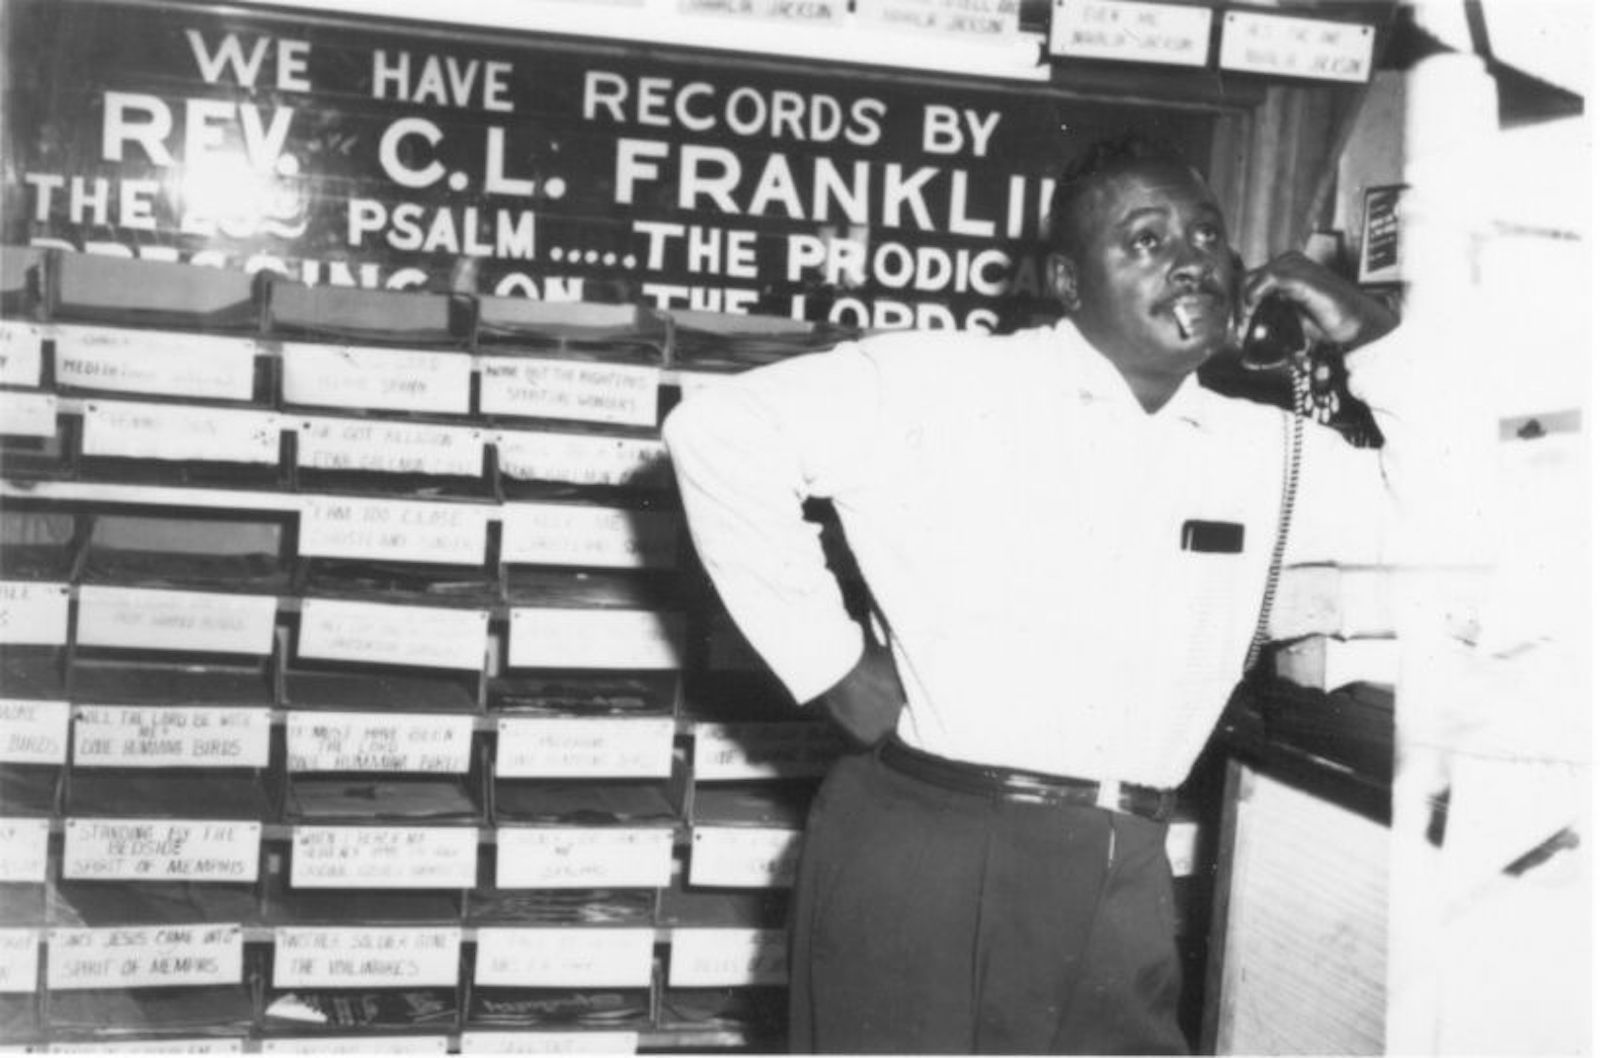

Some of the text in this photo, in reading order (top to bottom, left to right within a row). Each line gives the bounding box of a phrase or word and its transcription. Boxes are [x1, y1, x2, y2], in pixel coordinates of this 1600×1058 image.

[188, 30, 1001, 156] WE HAVE RECORDS BY
[615, 138, 1055, 240] FRANKLI
[25, 172, 159, 230] THE
[107, 839, 183, 856] BEDSIDE
[134, 859, 154, 874] OF
[166, 858, 245, 876] MEMPHIS
[102, 930, 148, 948] JESUS
[62, 959, 115, 977] SPIRIT
[120, 959, 141, 976] OF
